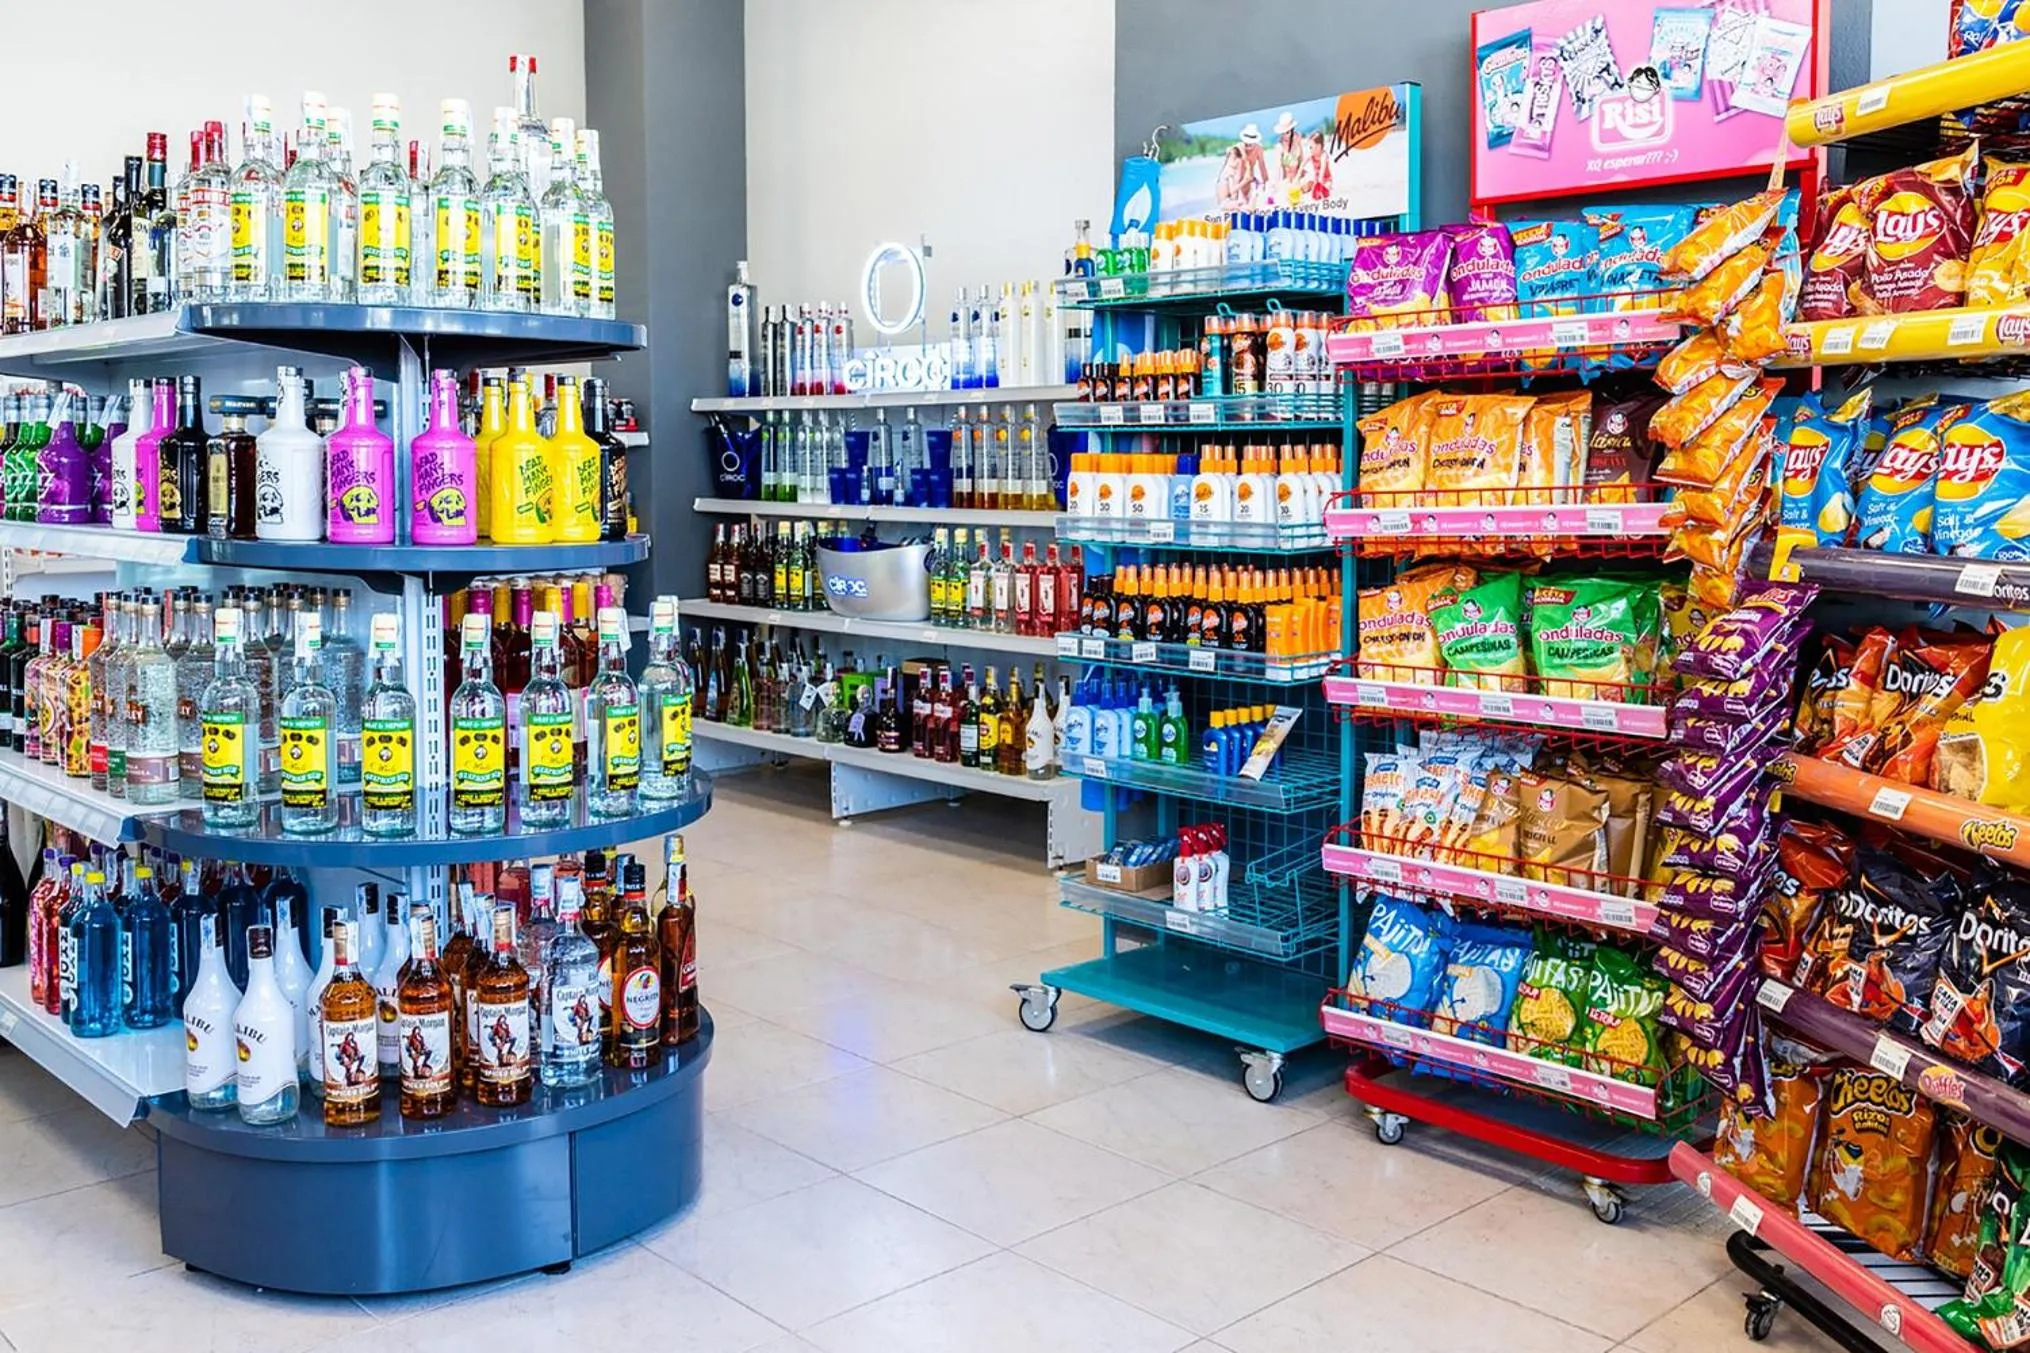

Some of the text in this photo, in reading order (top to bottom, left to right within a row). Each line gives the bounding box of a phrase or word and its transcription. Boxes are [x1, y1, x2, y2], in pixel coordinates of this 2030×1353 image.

[1330, 92, 1402, 155] Malibu
[1601, 98, 1664, 140] Risi
[1322, 198, 1348, 211] Body
[1875, 207, 1942, 244] Lay's
[1993, 581, 2030, 601] oritos
[1850, 891, 1932, 936] Doritos
[1959, 910, 2030, 960] Dorito
